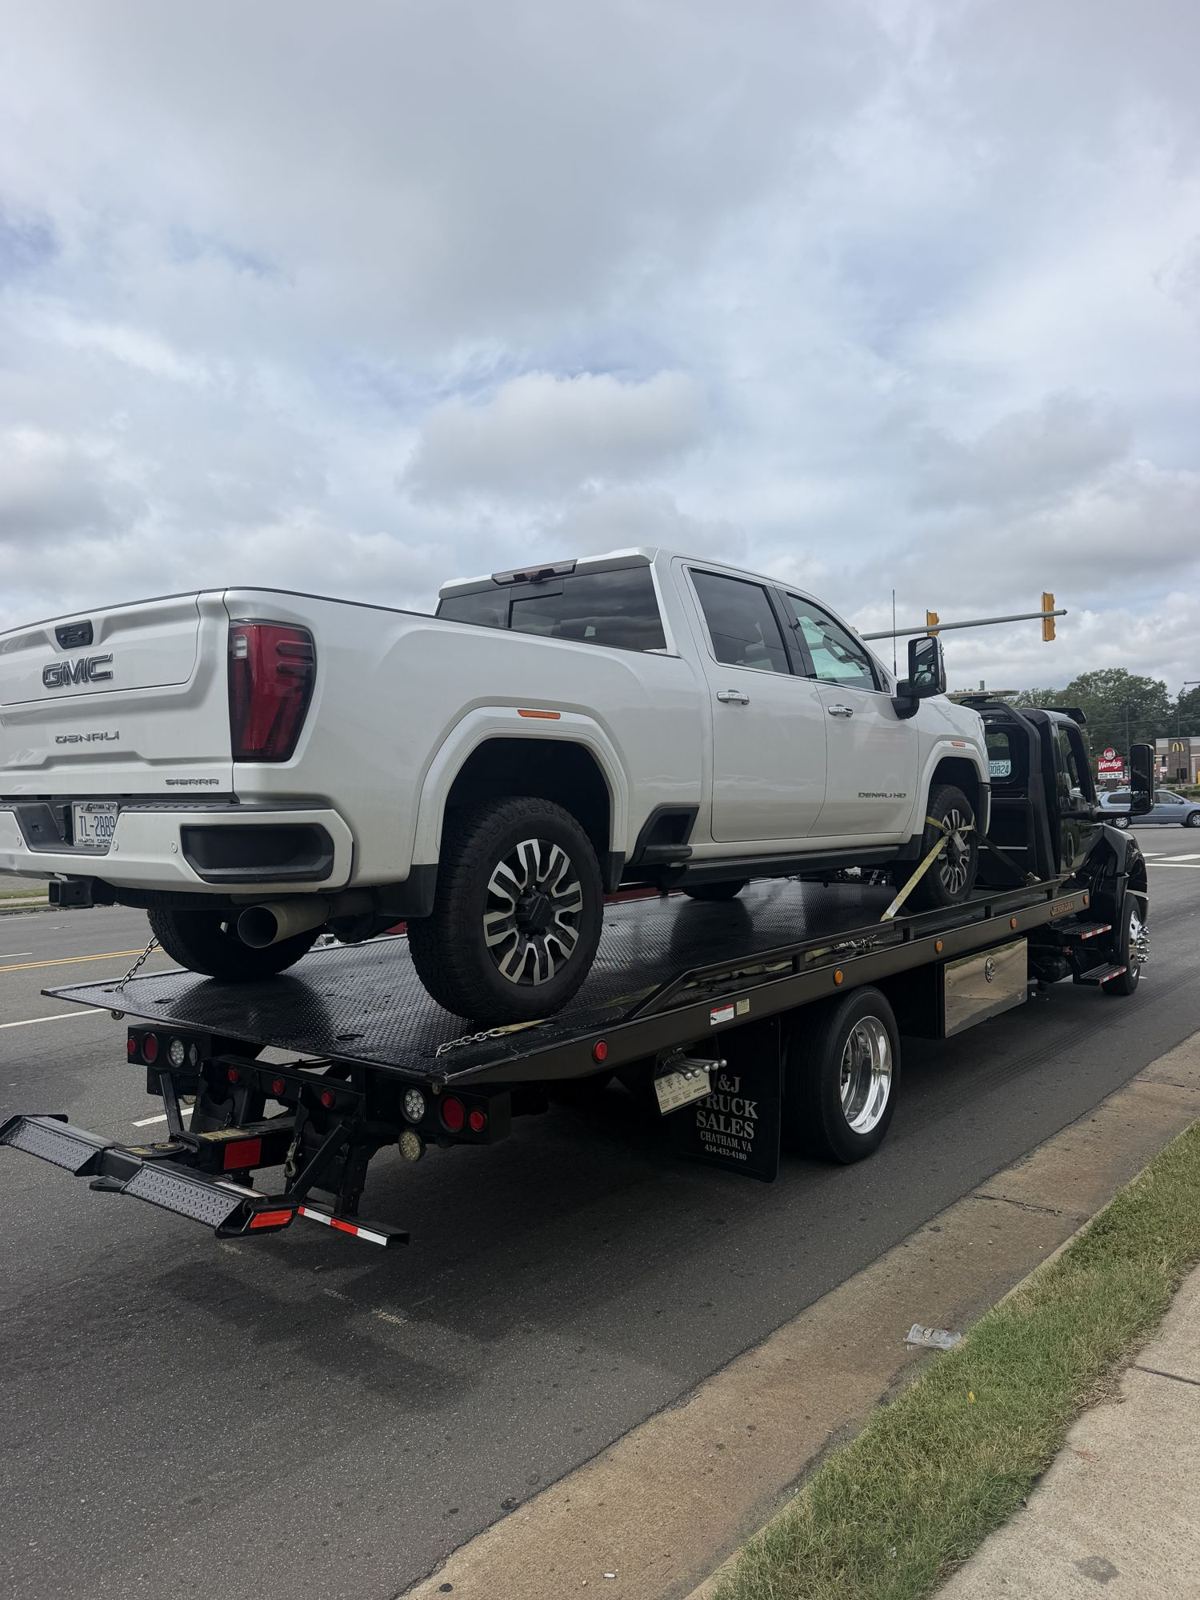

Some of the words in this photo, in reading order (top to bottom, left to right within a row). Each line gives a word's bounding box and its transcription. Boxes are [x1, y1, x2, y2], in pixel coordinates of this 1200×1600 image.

[42, 653, 113, 688] GMC
[54, 730, 120, 745] DENALI
[165, 778, 220, 786] SIERRA
[696, 1094, 759, 1120] RUCK
[696, 1110, 755, 1140] SALES
[700, 1130, 741, 1151] CHATHAM,
[741, 1140, 753, 1153] VA
